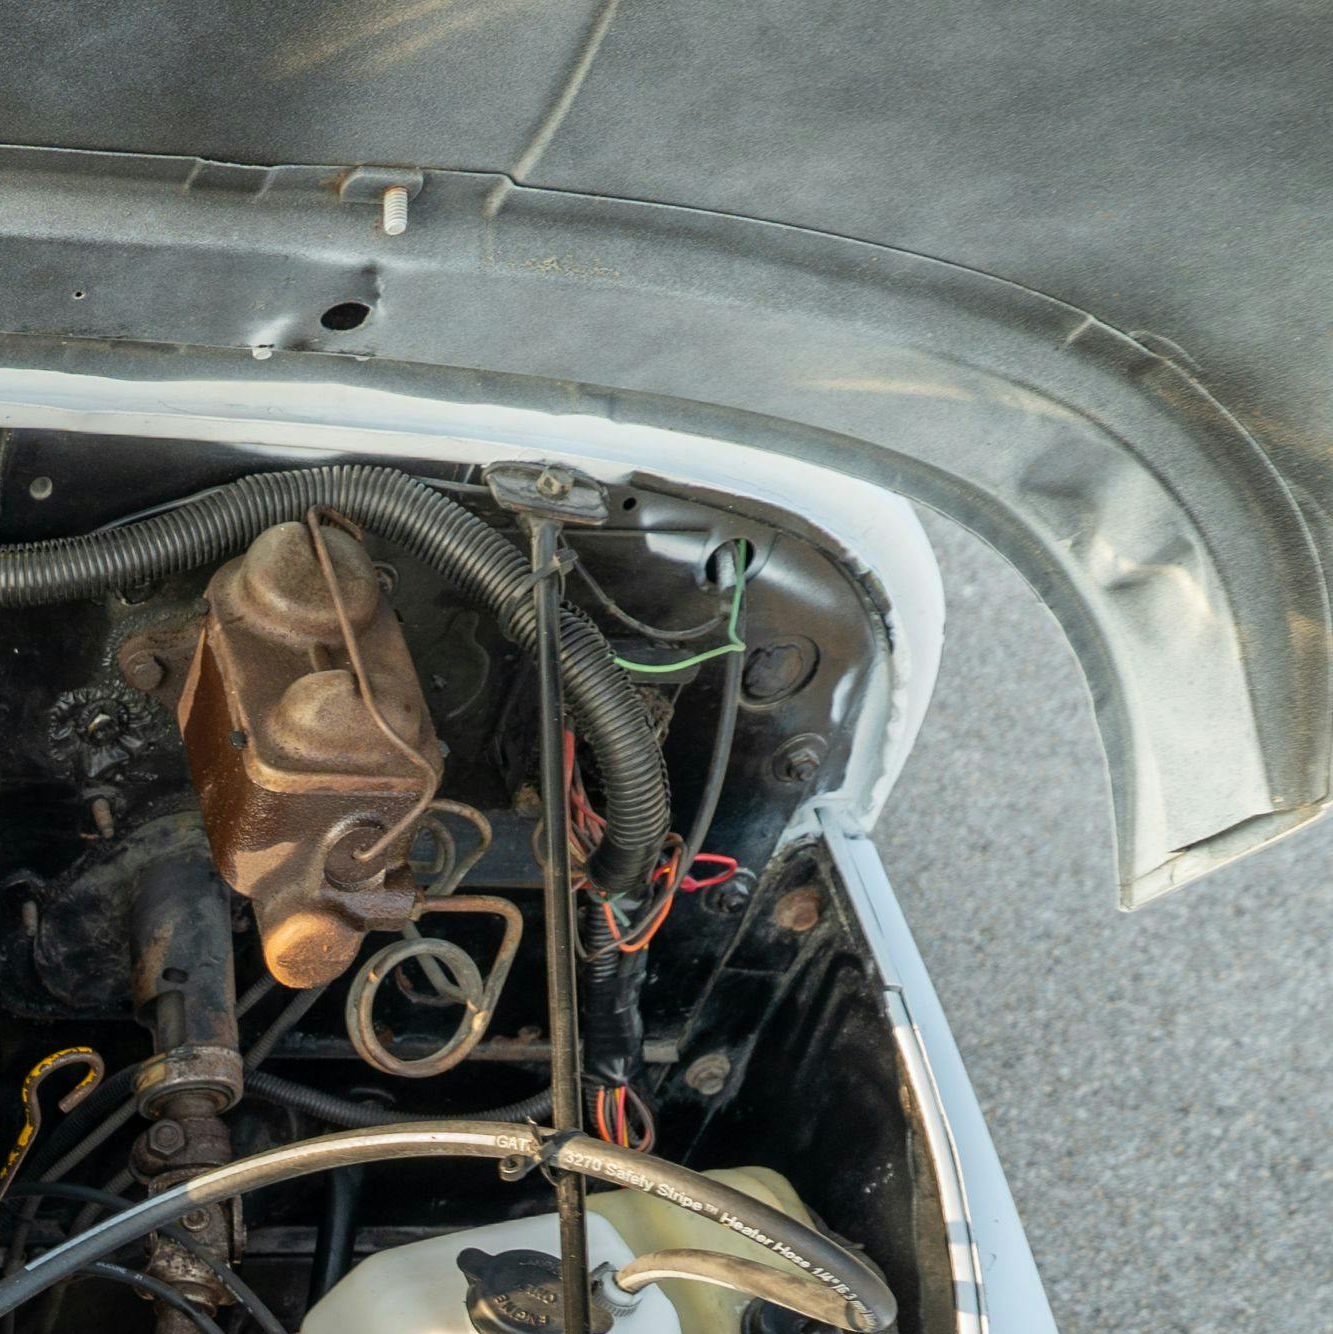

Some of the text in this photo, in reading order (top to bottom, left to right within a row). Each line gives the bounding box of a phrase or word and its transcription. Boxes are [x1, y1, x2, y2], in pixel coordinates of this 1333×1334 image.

[564, 1150, 602, 1171] 3270
[604, 1162, 654, 1192] Safety
[719, 1212, 775, 1248] Heater
[772, 1241, 811, 1269] Hose
